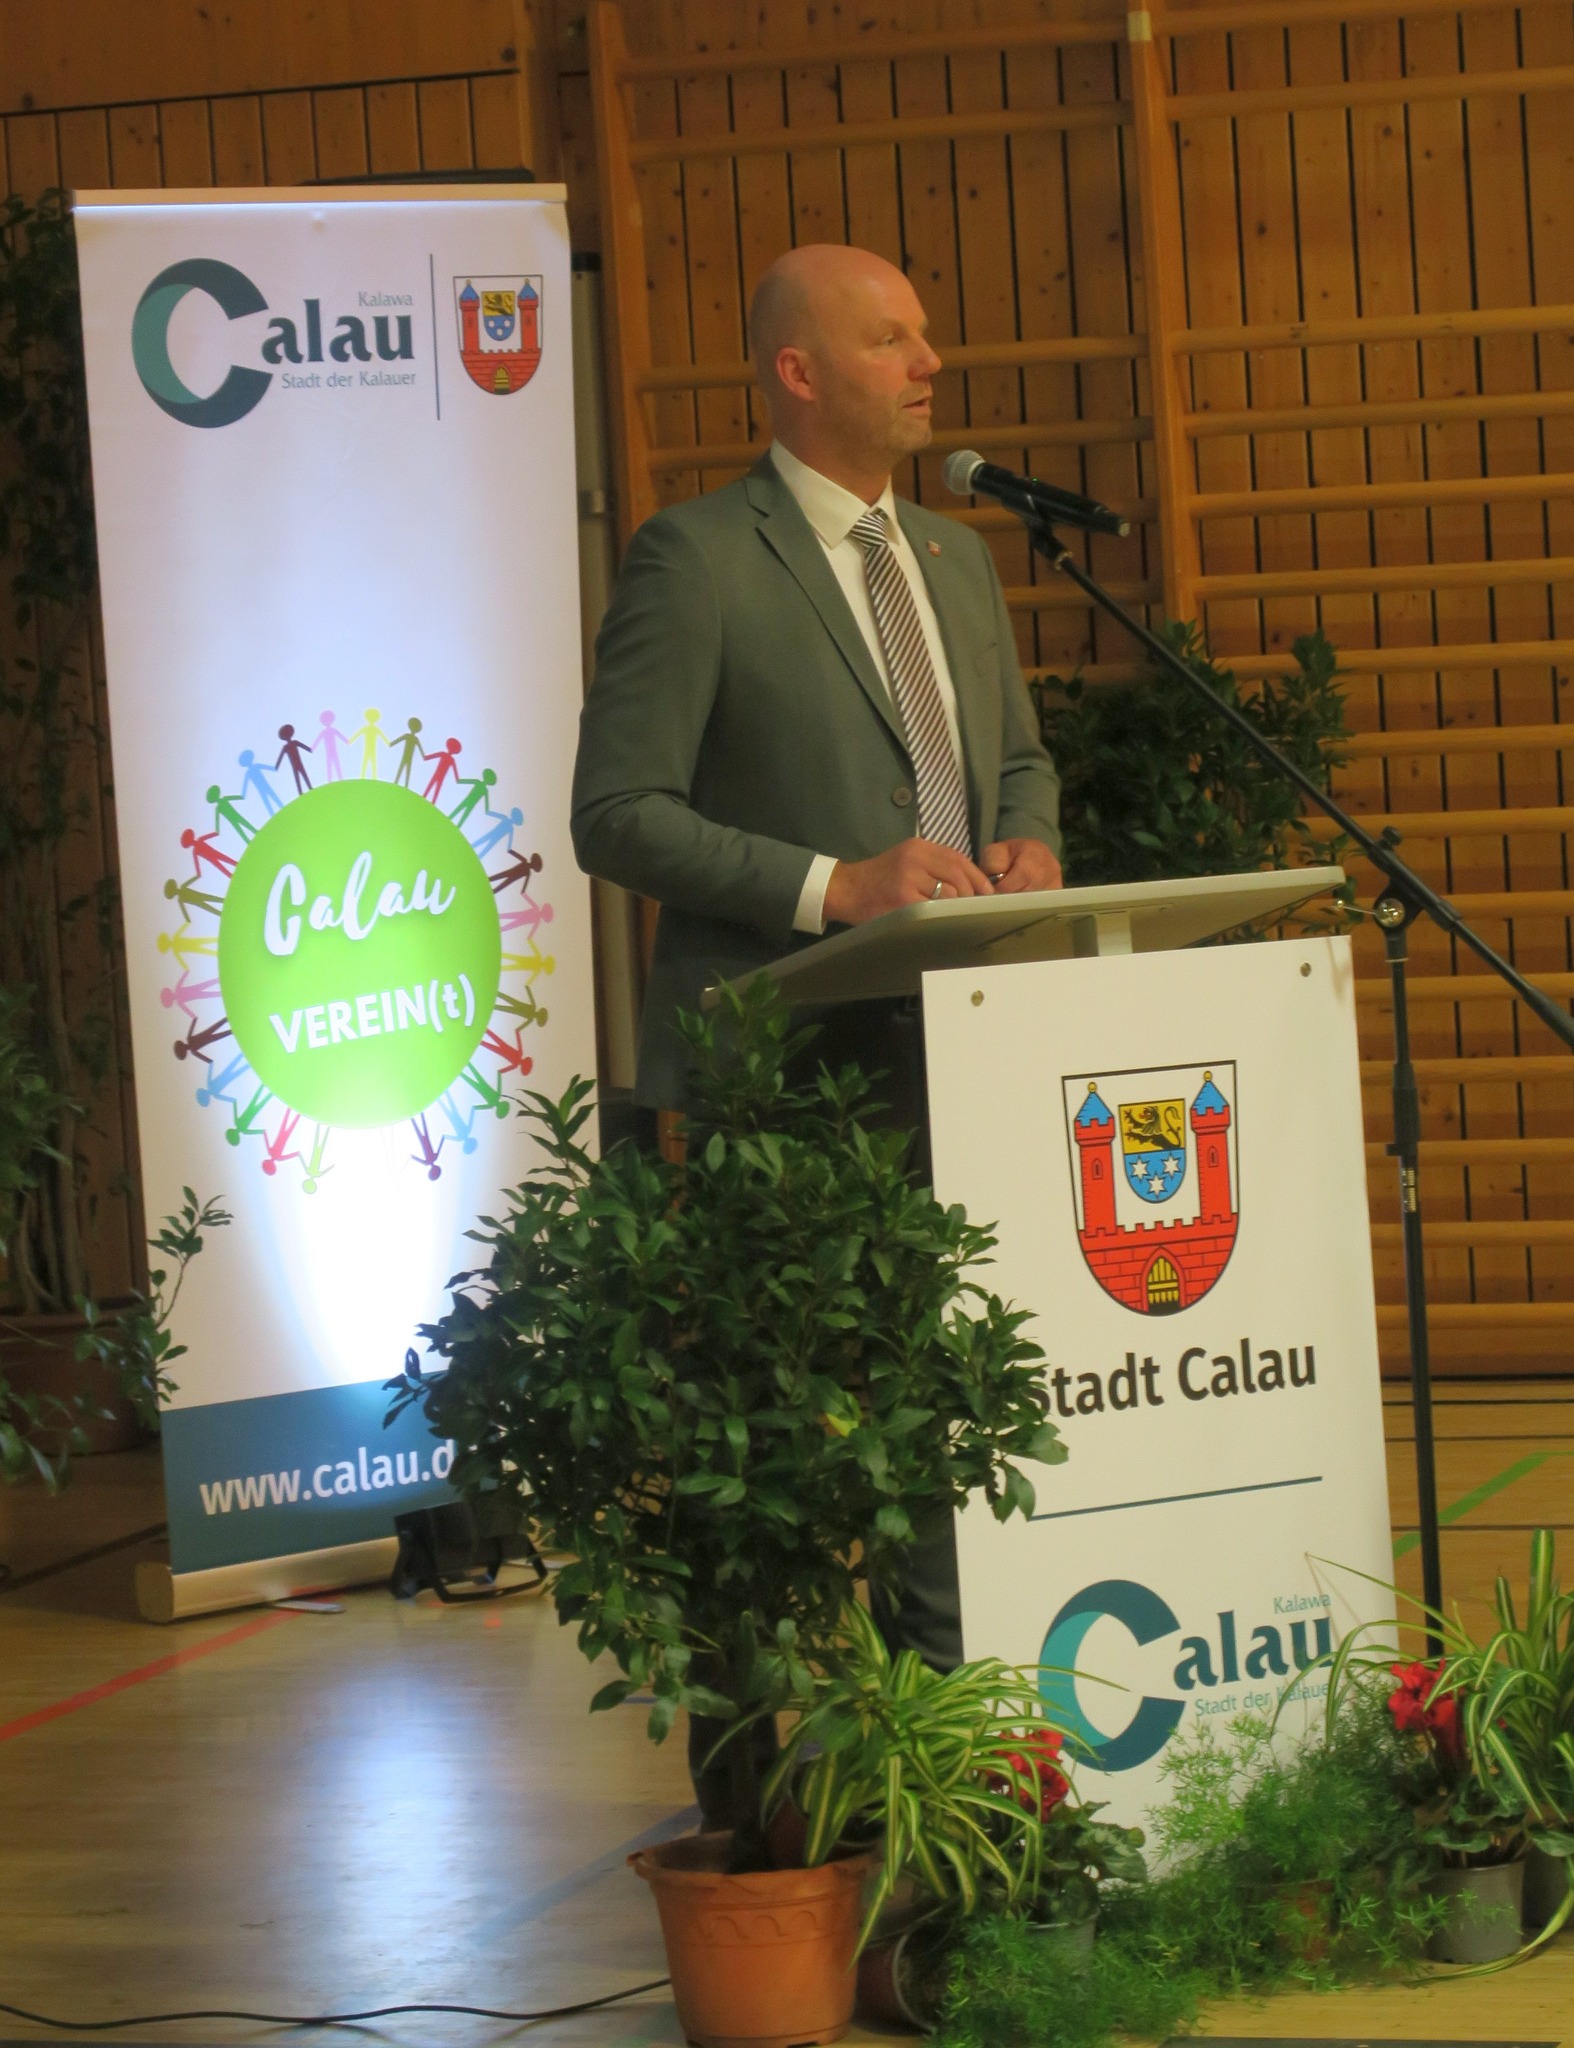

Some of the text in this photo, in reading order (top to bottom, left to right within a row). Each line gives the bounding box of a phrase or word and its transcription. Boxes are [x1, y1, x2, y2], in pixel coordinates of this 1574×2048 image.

[358, 291, 414, 307] Kalawa
[131, 257, 416, 429] Calau
[281, 369, 417, 389] Stadt der Kalauer
[263, 850, 457, 957] Calau
[268, 973, 476, 1054] VEREIN(t)
[1178, 1337, 1317, 1401] Calau
[200, 1438, 455, 1516] www.calau.d
[1273, 1593, 1332, 1615] Kalawa
[1037, 1578, 1334, 1773] Calau
[1195, 1694, 1238, 1717] Stadt
[1243, 1690, 1272, 1709] der
